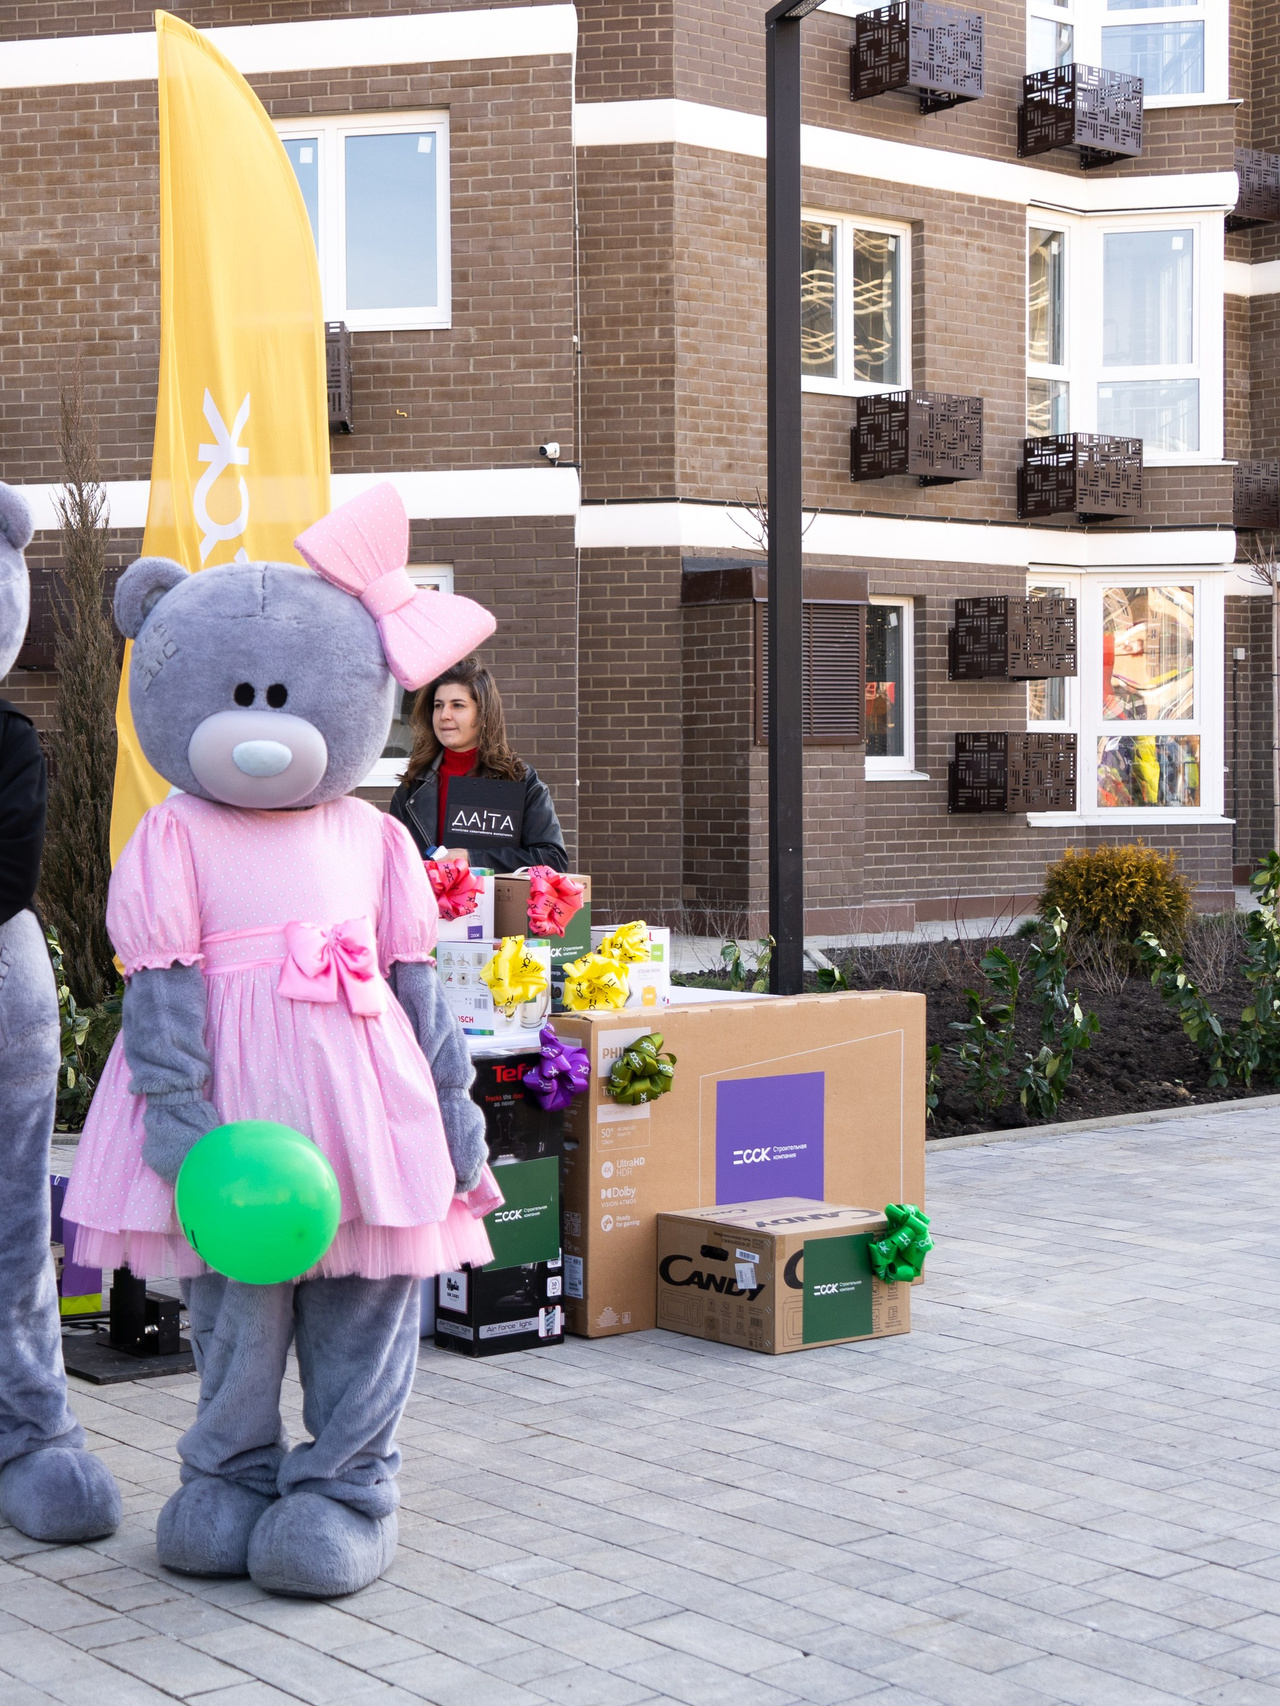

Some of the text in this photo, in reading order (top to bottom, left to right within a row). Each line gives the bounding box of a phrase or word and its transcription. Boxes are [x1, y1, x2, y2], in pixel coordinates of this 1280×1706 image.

[772, 1143, 808, 1153] Строительная
[772, 1152, 797, 1160] компания
[612, 1185, 637, 1198] Dolby
